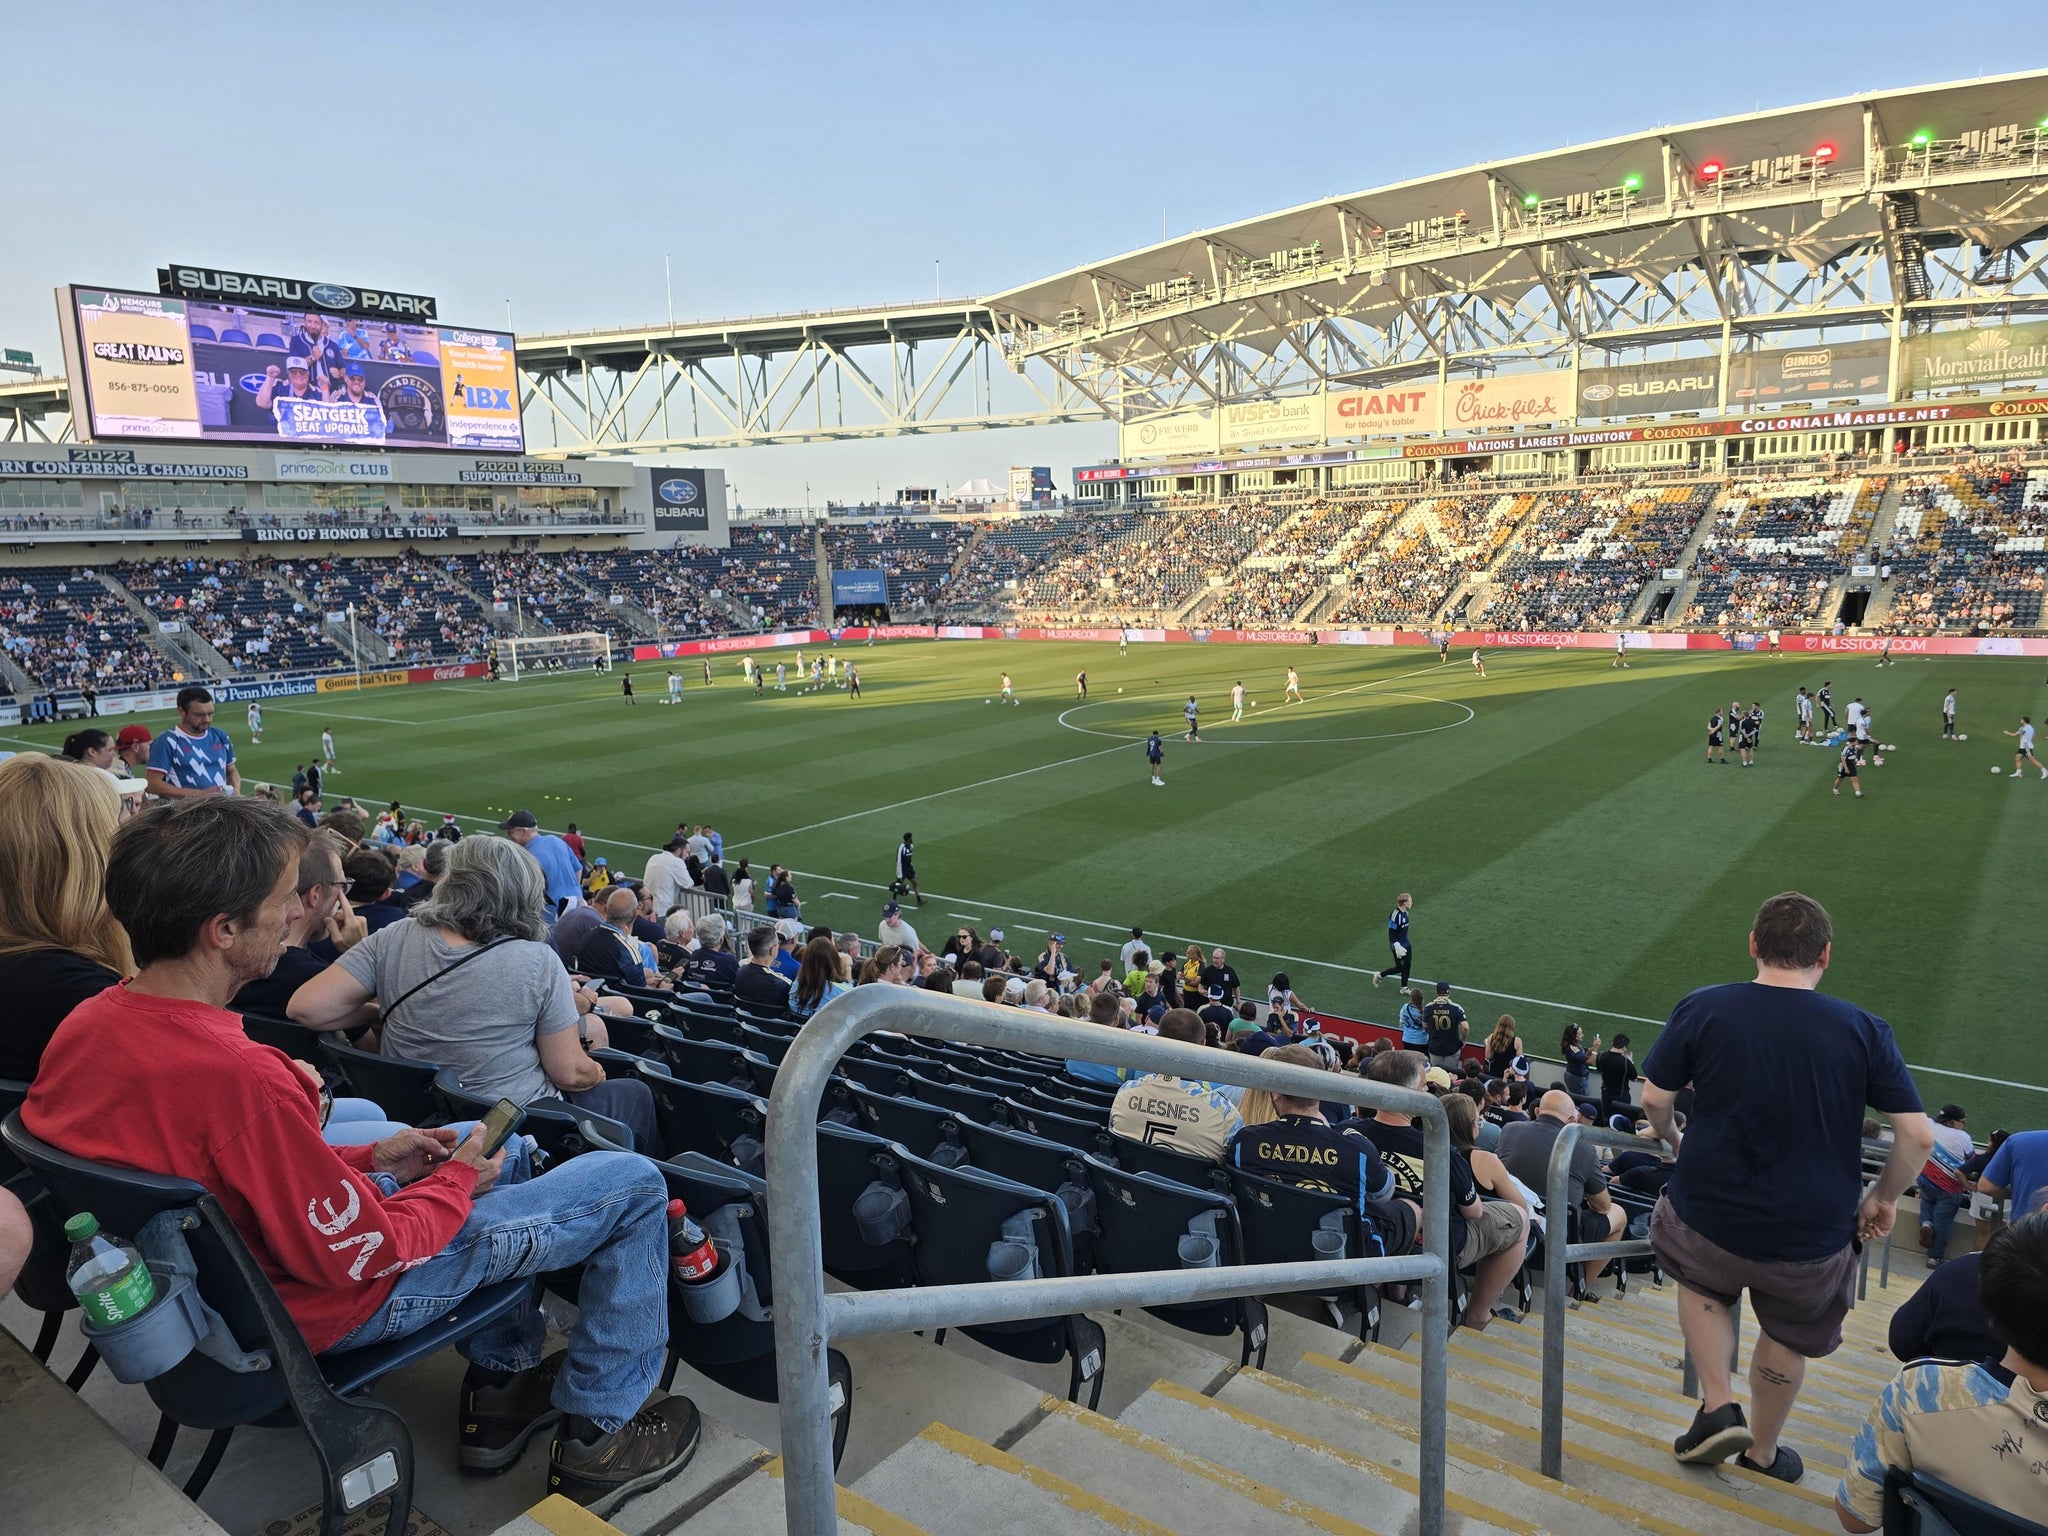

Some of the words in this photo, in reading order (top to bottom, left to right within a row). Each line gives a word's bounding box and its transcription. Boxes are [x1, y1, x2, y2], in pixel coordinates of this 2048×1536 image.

[177, 269, 302, 300] SUBARU
[361, 292, 433, 317] PARK
[120, 297, 162, 309] NEMOURS
[453, 331, 480, 345] College
[94, 343, 135, 360] GREAT
[137, 344, 183, 362] RAILING
[452, 360, 477, 369] health
[1785, 354, 1828, 368] BIMBO
[1924, 345, 2048, 378] MoraviaHealth
[1782, 371, 1809, 379] Bakeries
[1931, 377, 1953, 386] HOME
[1955, 373, 2003, 384] HEALTHCARE
[2005, 370, 2043, 379] SERVICES
[108, 382, 180, 395] 856-875-0050
[1617, 375, 1714, 397] SUBARU
[466, 386, 512, 411] IBX
[1337, 392, 1426, 417] GIANT
[293, 405, 368, 424] SEATGEEK
[1227, 403, 1281, 424] WSFS
[1282, 403, 1310, 417] bank
[1456, 392, 1557, 423] Chick-fil-A
[295, 422, 321, 433] SEAT
[325, 423, 370, 435] UPGRADE
[450, 420, 507, 432] Independence
[1345, 421, 1356, 430] for
[1358, 419, 1390, 429] today's
[1392, 417, 1415, 426] table
[1405, 445, 1463, 457] COLONIAL
[1467, 440, 1515, 452] NATIONS
[1519, 435, 1565, 449] LARGEST
[1568, 430, 1633, 445] INVENTORY
[1643, 425, 1712, 440] COLONIAL
[1741, 408, 1949, 433] COLONIALMARBLE.NET
[73, 450, 131, 463] 2022
[1236, 459, 1253, 468] MATCH
[1254, 458, 1271, 466] STATS
[0, 461, 27, 473] RN
[32, 461, 148, 476] CONFERENCE
[151, 464, 247, 478] CHAMPIONS
[280, 464, 347, 476] primepoint
[350, 464, 389, 476] CLUB
[480, 461, 517, 471] 2020
[462, 471, 538, 482] SUPPORTERS'
[540, 473, 579, 483] SHIELD
[655, 507, 705, 518] SUBARU
[256, 529, 295, 541] RING
[297, 528, 317, 540] OF
[319, 528, 370, 540] HONOR
[384, 527, 404, 539] LE
[406, 527, 448, 538] TOUX
[1047, 630, 1098, 640] MLSSTORE.COM
[1246, 631, 1309, 643] MLSSTORE.COM
[1498, 633, 1578, 646] MLSSTORE.COM
[1821, 637, 1927, 652] MLSSTOR.COM
[382, 673, 402, 684] Tire
[433, 665, 466, 680] Coca-Cola
[229, 687, 264, 701] Penn
[264, 683, 316, 698] Medicine
[1433, 1014, 1452, 1031] 10
[1128, 1095, 1200, 1124] GLESNES
[1258, 1142, 1339, 1167] GAZDAG
[98, 1291, 124, 1321] Sprite
[1087, 1354, 1096, 1374] R
[359, 1461, 376, 1496] T
